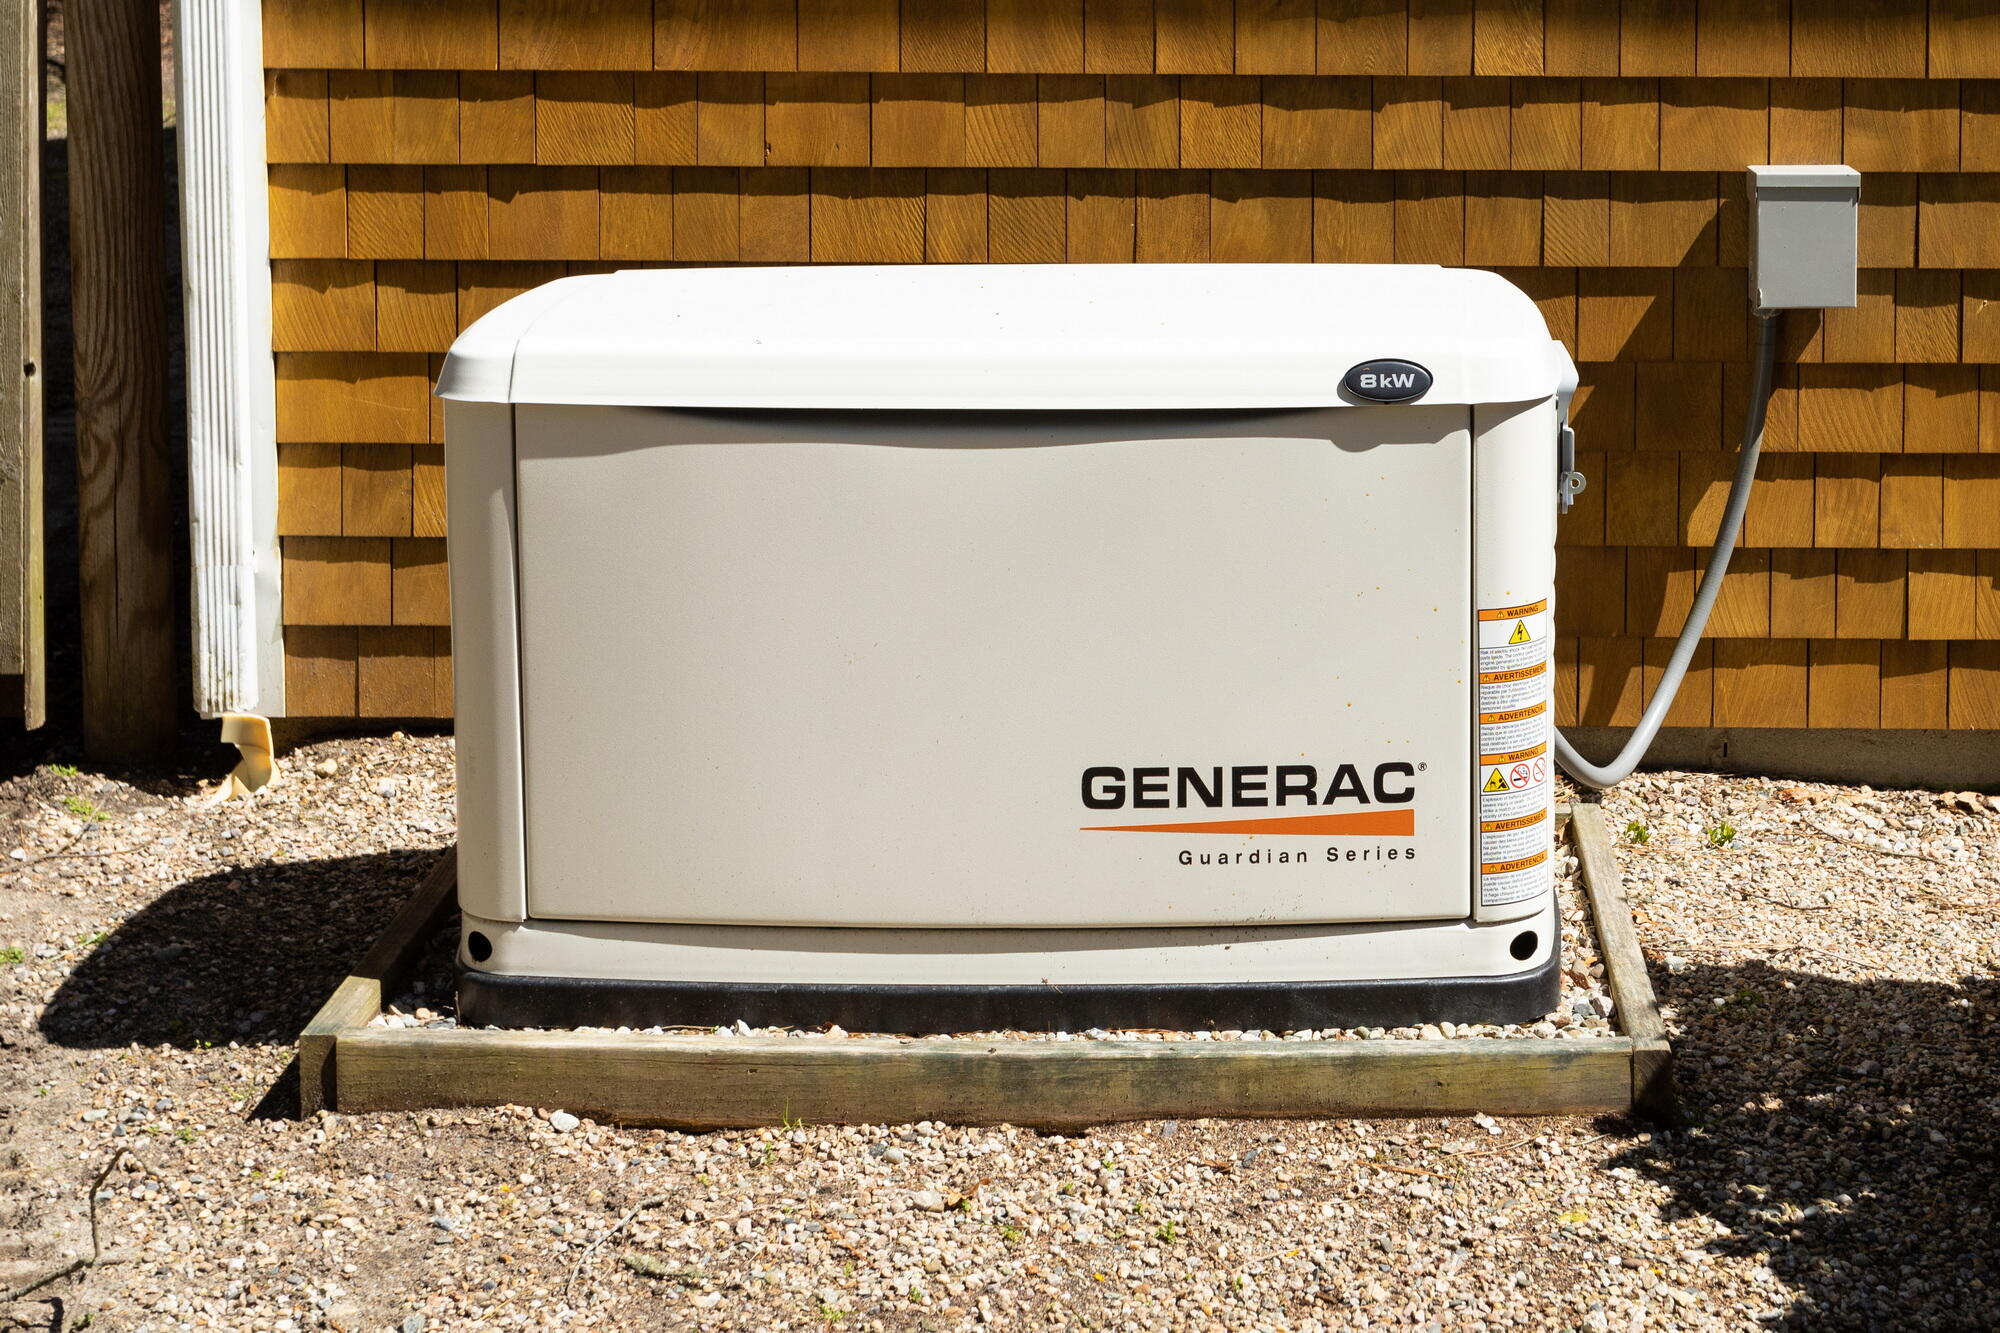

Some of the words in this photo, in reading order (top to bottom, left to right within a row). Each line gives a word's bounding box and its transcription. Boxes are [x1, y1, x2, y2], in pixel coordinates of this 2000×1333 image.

[1360, 373, 1377, 388] 8
[1380, 373, 1415, 388] kW
[1507, 605, 1539, 617] WARNING
[1508, 748, 1539, 761] WARNING
[1178, 848, 1307, 866] Guardian
[1326, 846, 1416, 862] Series
